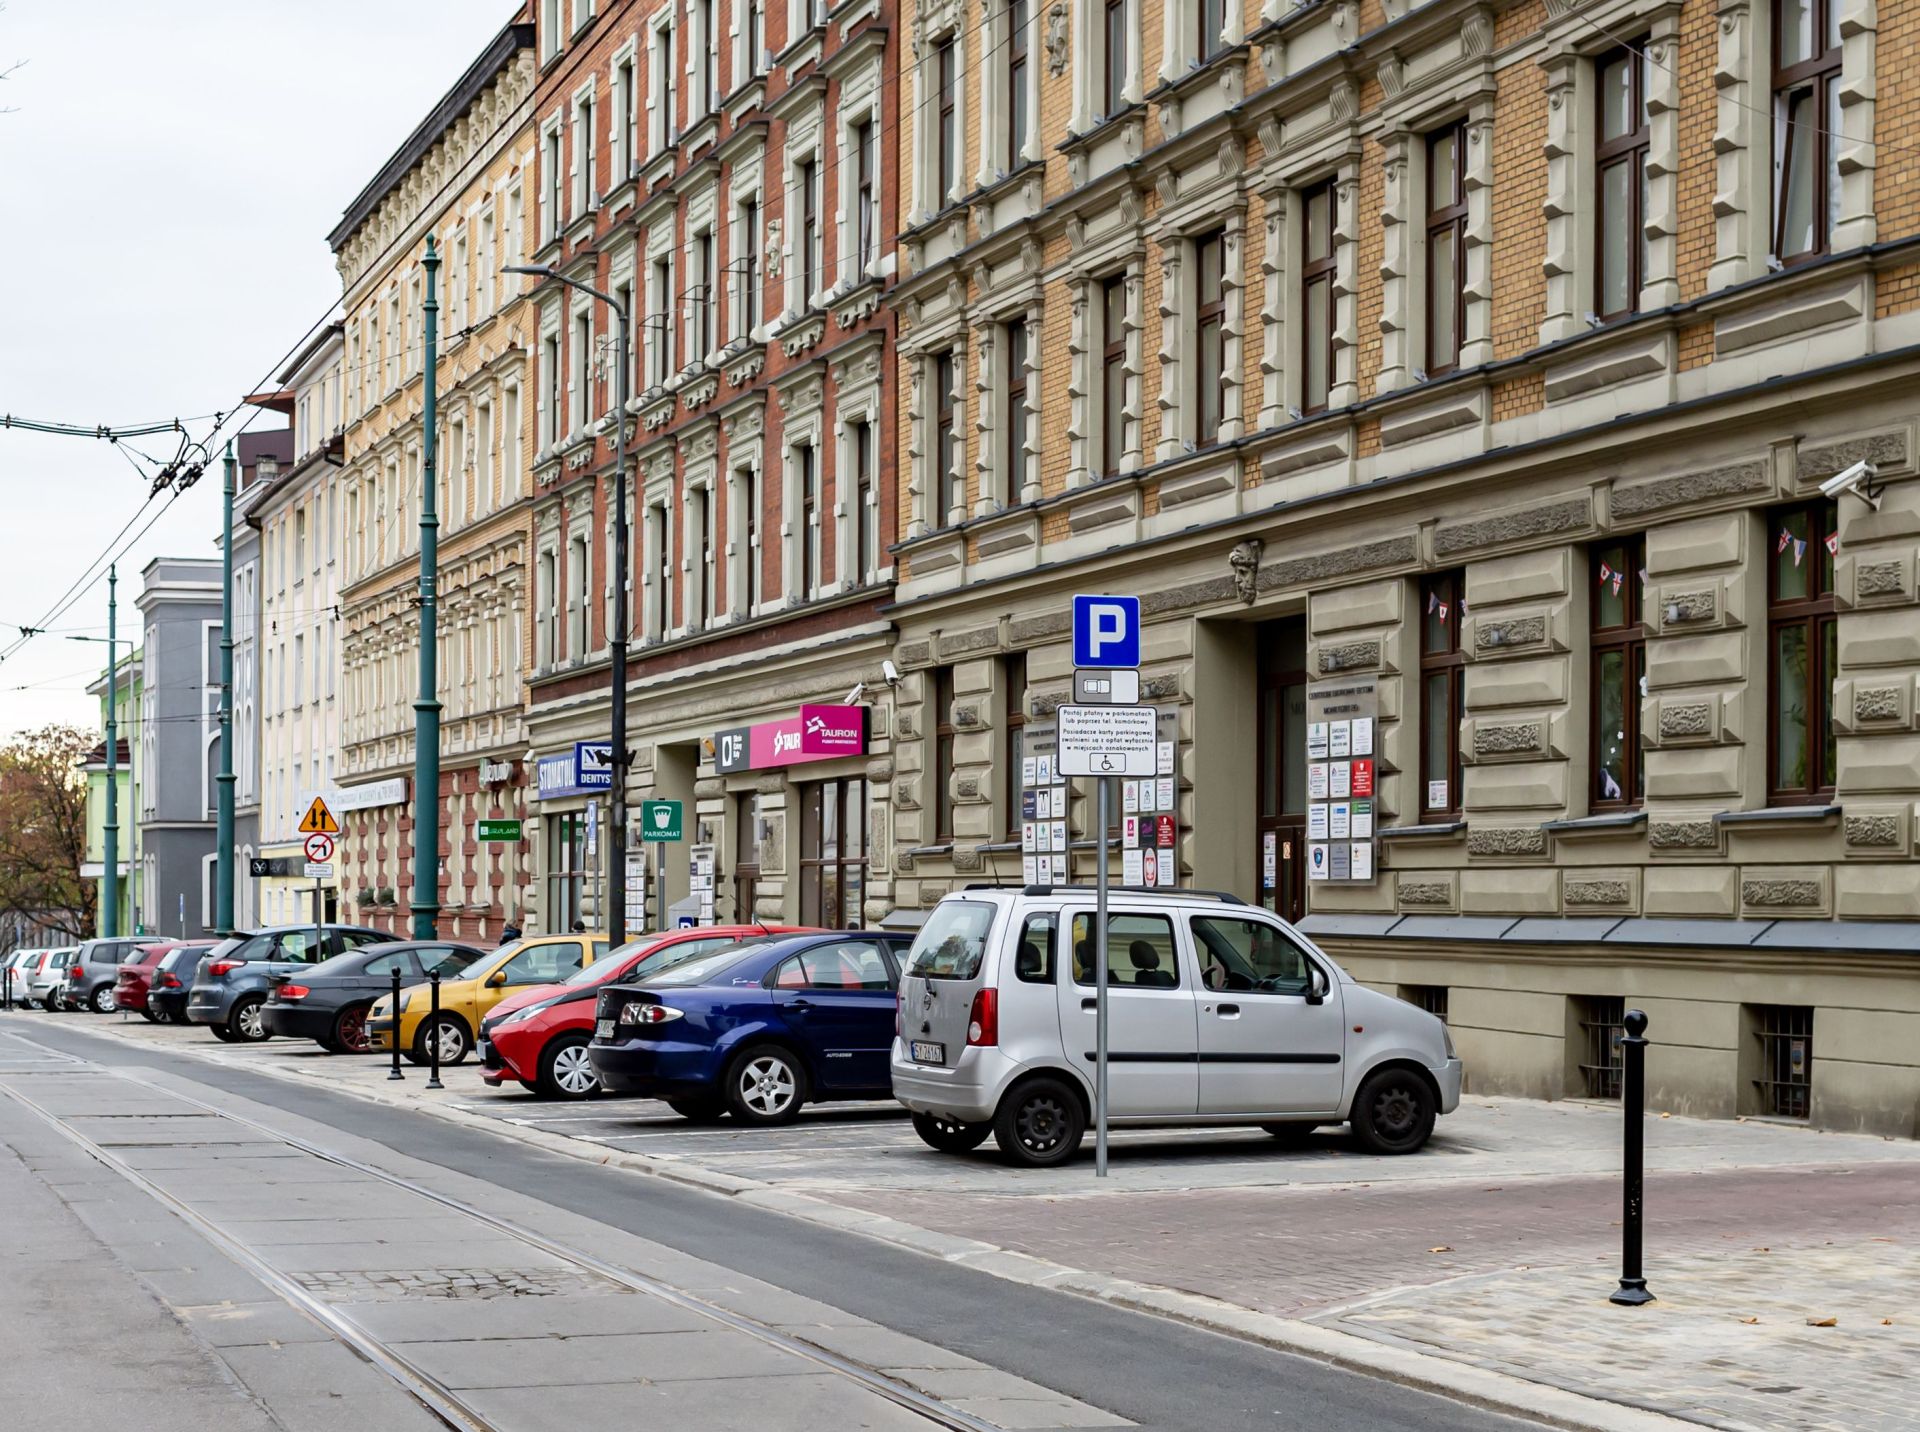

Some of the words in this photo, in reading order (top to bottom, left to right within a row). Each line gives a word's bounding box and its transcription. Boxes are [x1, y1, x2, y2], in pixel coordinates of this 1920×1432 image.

[1090, 604, 1126, 658] P
[820, 729, 857, 738] TAURON
[1115, 729, 1152, 737] parkingowej
[581, 773, 612, 784] DENTYS
